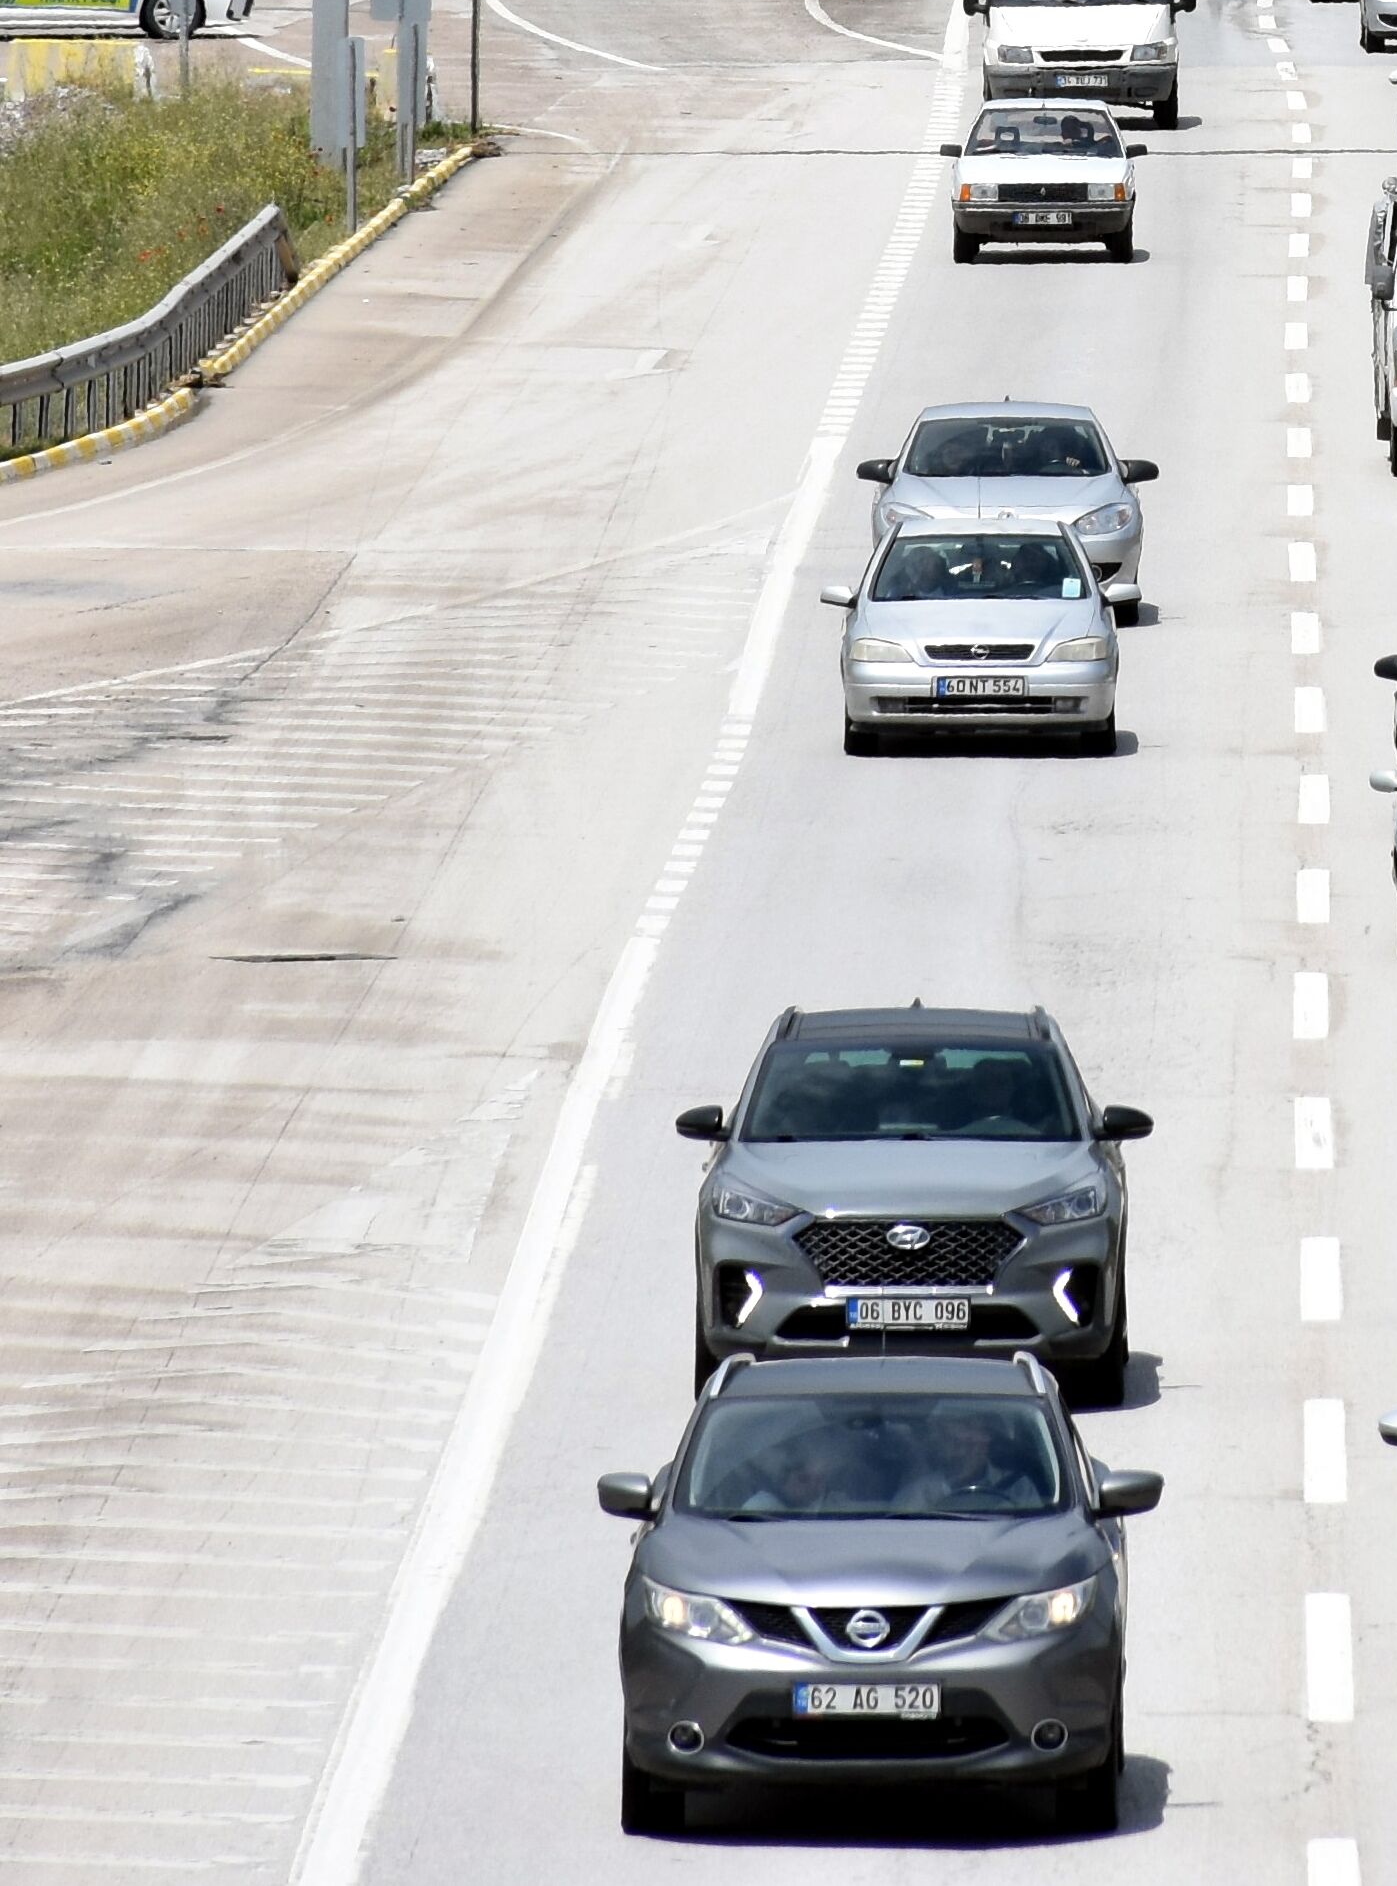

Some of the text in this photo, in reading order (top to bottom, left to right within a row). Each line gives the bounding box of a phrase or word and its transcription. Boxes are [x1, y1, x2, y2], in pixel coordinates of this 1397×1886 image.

[946, 679, 1020, 694] 60 NT 554
[859, 1301, 880, 1320] 06
[891, 1301, 923, 1321] BYC
[934, 1301, 966, 1321] 096
[811, 1686, 837, 1709] 62
[852, 1687, 879, 1709] AG
[894, 1687, 934, 1709] 520
